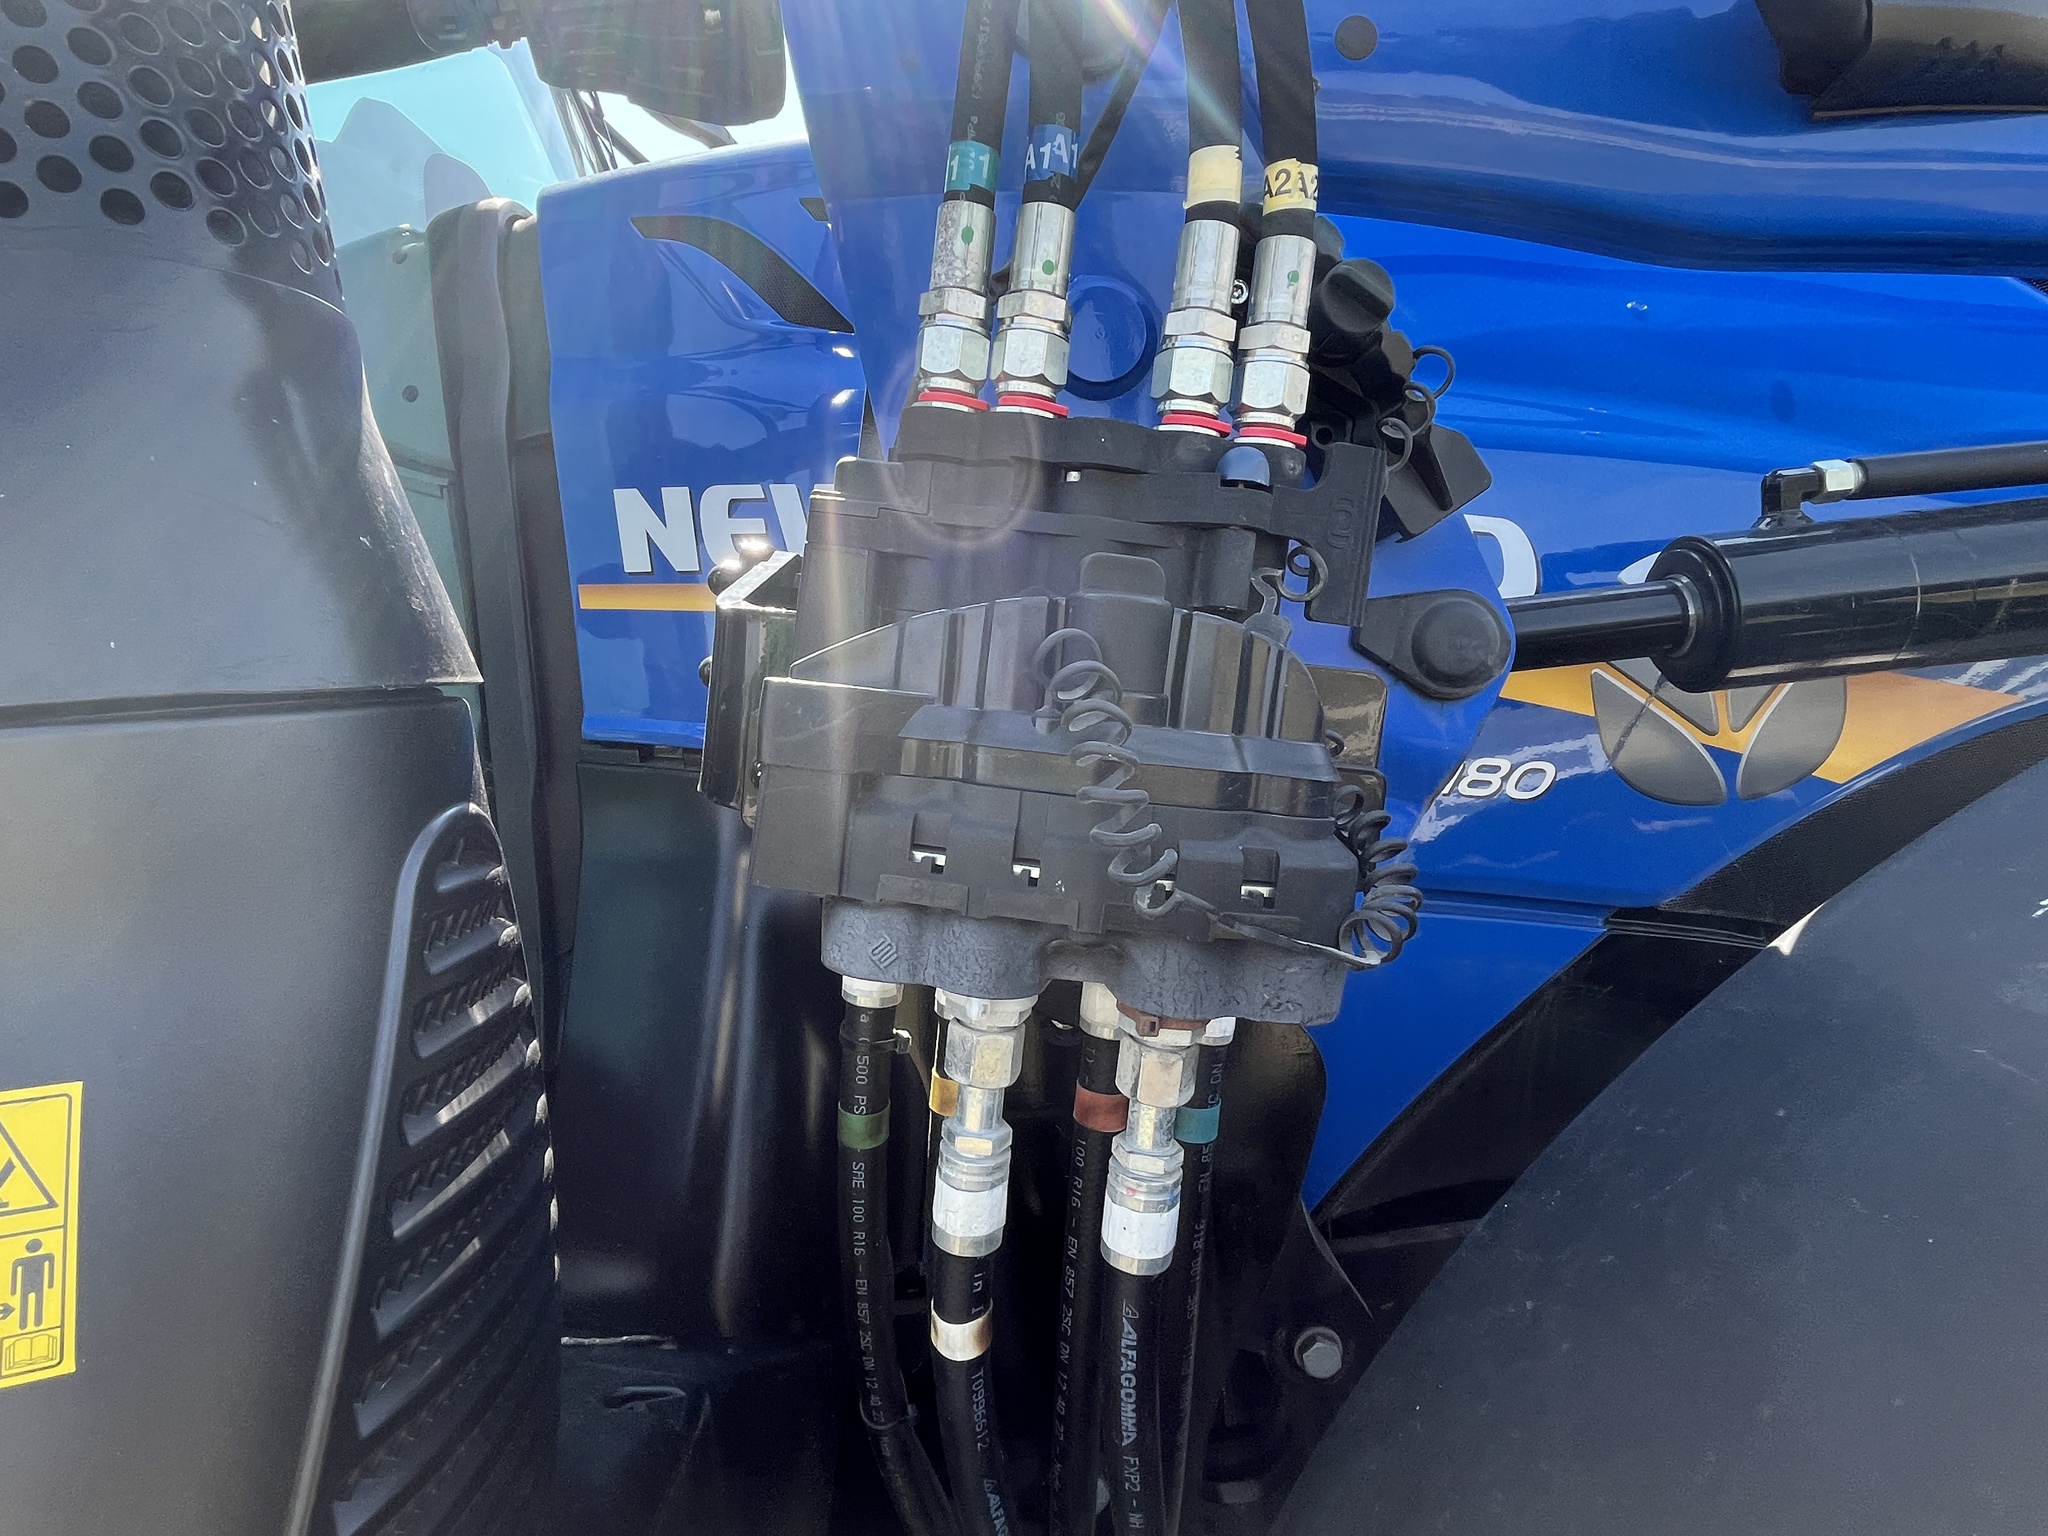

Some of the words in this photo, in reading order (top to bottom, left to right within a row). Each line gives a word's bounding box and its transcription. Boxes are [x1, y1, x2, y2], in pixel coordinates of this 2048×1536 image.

[1263, 168, 1292, 199] A2
[1075, 1138, 1087, 1168] 100
[852, 1162, 865, 1189] SAE
[1071, 1176, 1083, 1208] R16
[853, 1199, 865, 1223] 100
[853, 1231, 866, 1257] R16
[1067, 1235, 1078, 1260] EN
[855, 1279, 868, 1296] EN
[1064, 1265, 1075, 1299] 857
[857, 1302, 870, 1324] 857
[1120, 1316, 1138, 1447] ALFAGOMMA
